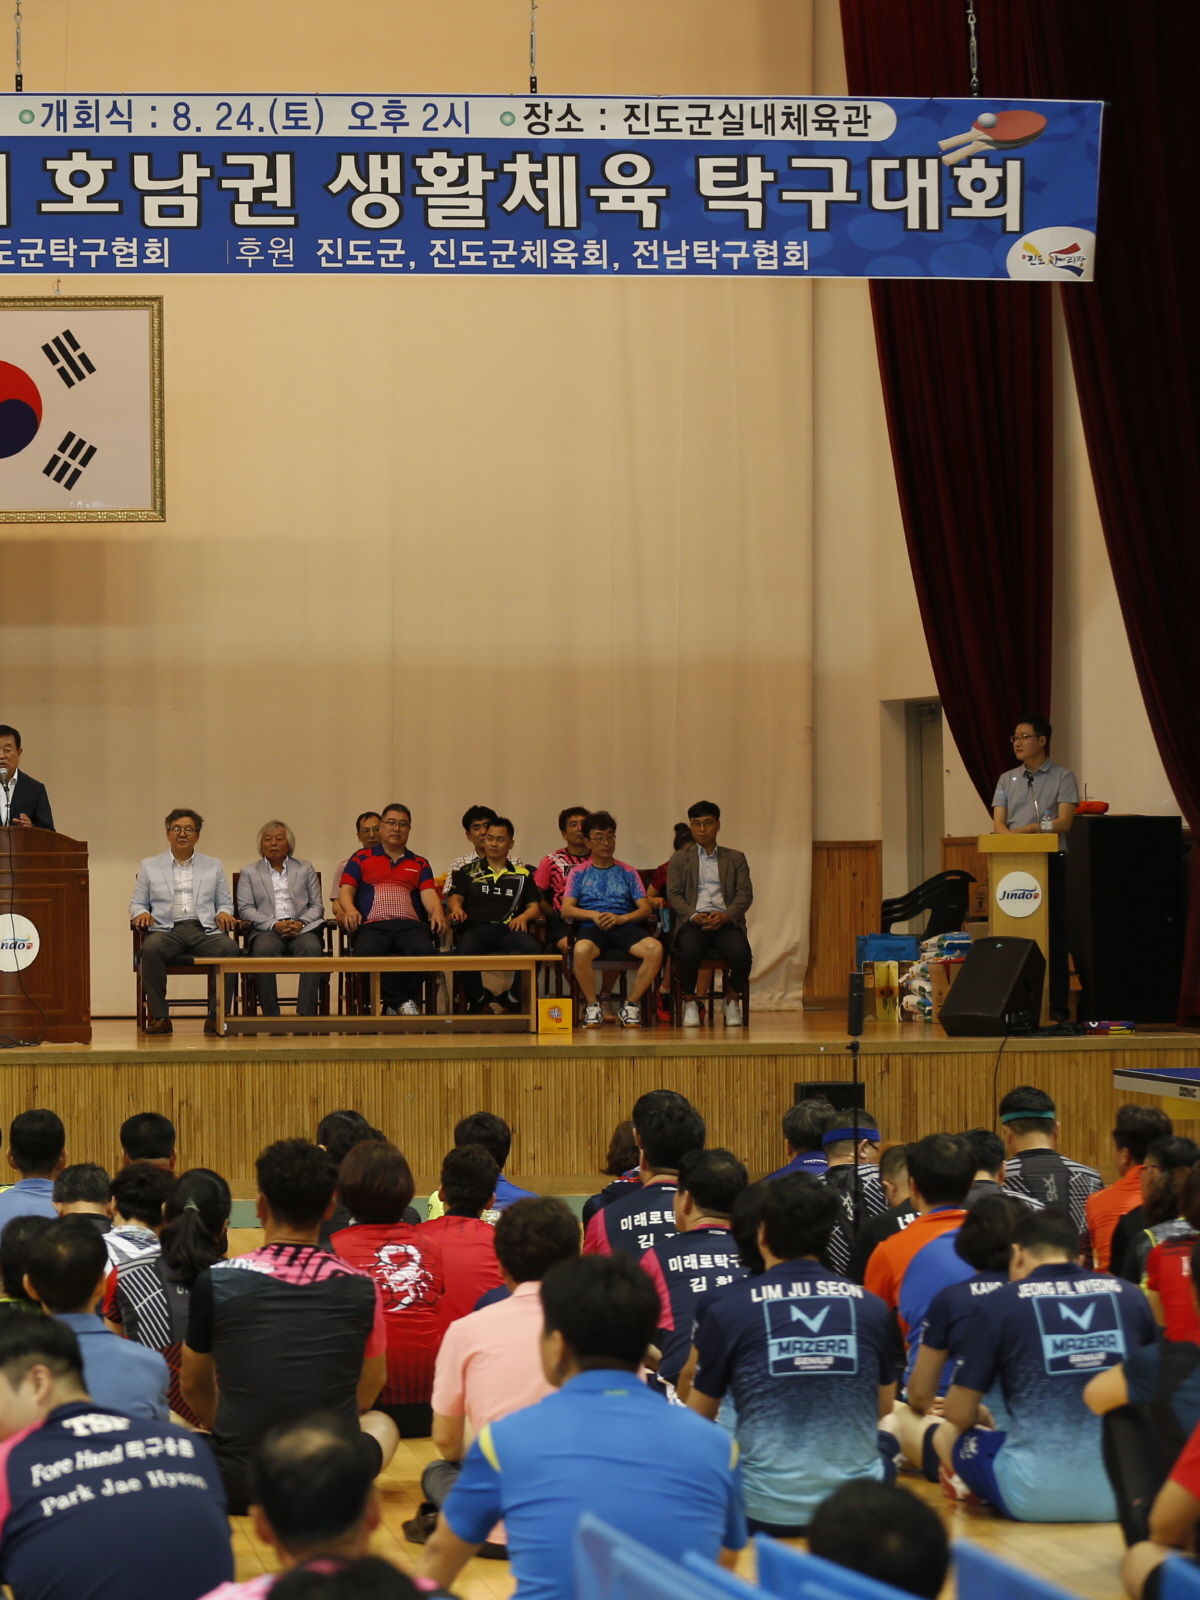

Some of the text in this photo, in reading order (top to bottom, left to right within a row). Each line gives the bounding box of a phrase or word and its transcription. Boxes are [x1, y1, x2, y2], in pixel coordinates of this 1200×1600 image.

[40, 98, 133, 134] 개회식
[347, 99, 410, 134] 오후
[422, 100, 470, 135] 2시
[523, 101, 584, 136] 장소
[623, 103, 872, 138] 진도군실내체육관
[36, 148, 300, 230] 호남권
[321, 148, 671, 232] 생활체육
[695, 154, 1025, 234] 탁구대회
[235, 237, 810, 272] 후원 진도군, 진도군체육회, 전남탁구협회
[999, 889, 1033, 901] Jindo
[751, 1280, 864, 1302] LIM JU SEON
[777, 1339, 849, 1356] MAZERA
[1052, 1334, 1117, 1353] MAZERA
[30, 1458, 74, 1488] Fore
[40, 1484, 96, 1517] Park
[101, 1477, 143, 1497] Jae
